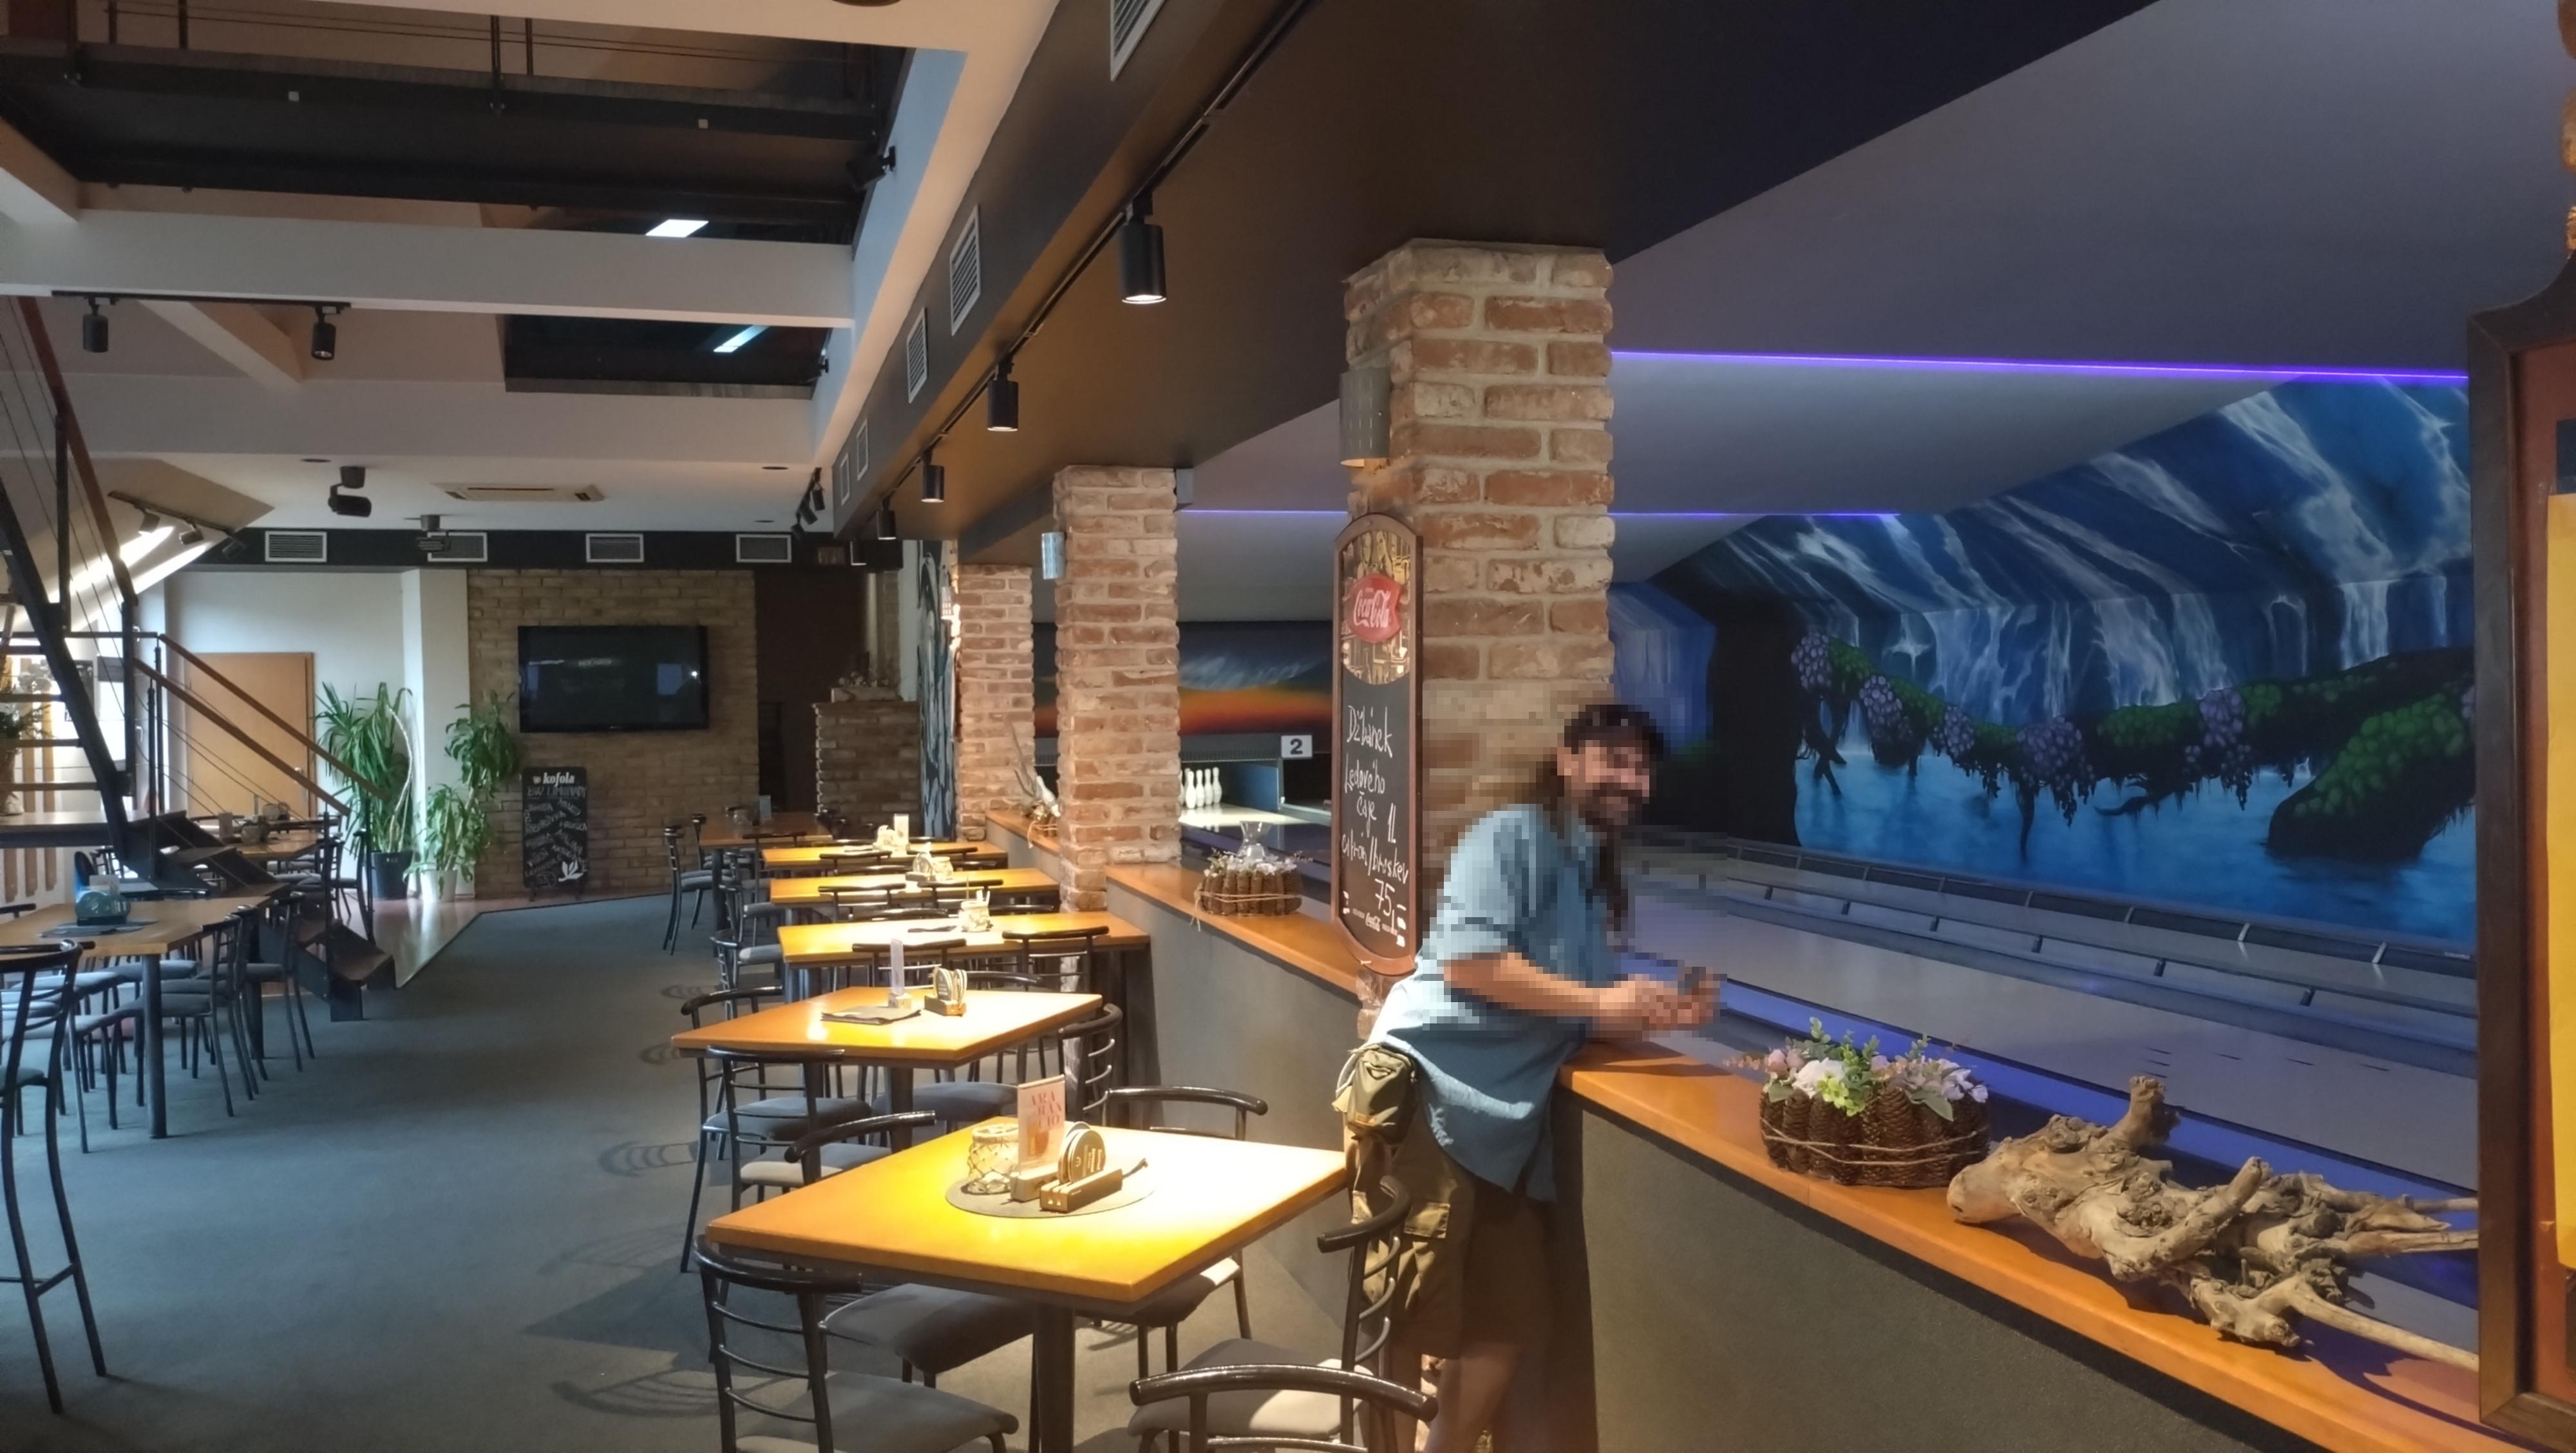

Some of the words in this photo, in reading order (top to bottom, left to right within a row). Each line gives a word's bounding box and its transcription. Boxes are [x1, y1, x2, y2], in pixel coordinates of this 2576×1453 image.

[1347, 705, 1393, 759] Džbánek
[1290, 738, 1303, 755] 2
[542, 772, 575, 787] kofola
